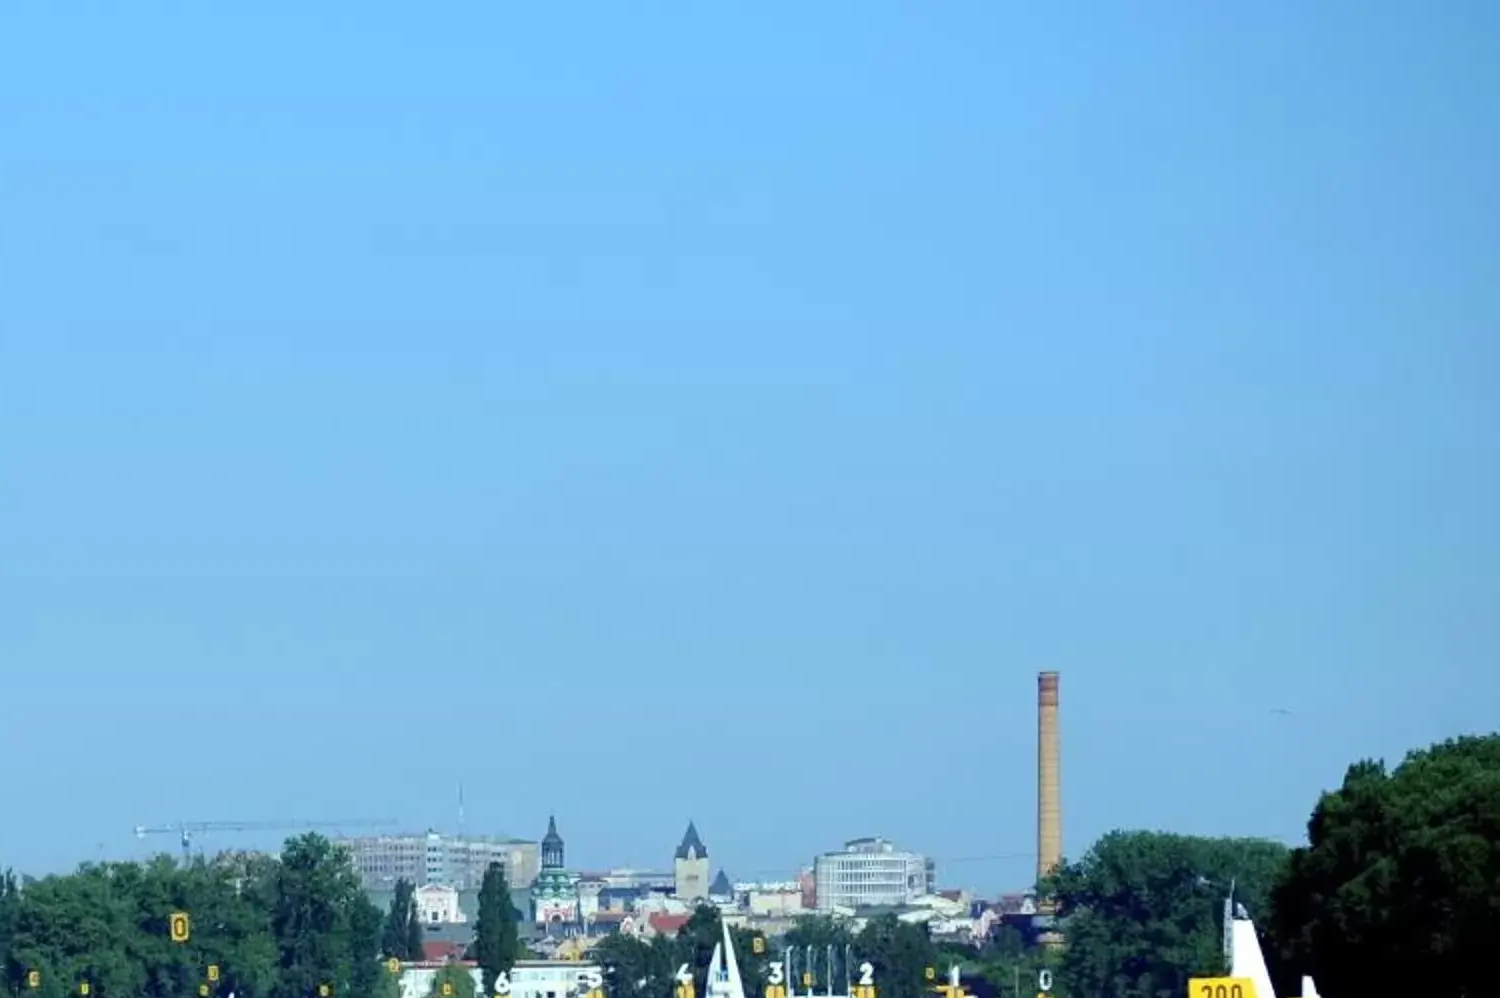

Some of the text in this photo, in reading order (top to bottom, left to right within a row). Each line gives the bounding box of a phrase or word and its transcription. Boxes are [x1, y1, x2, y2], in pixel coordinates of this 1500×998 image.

[173, 917, 186, 938] 0
[494, 970, 510, 994] 6
[587, 966, 603, 989] 5
[675, 963, 693, 986] 4
[768, 961, 784, 985] 3
[859, 961, 874, 985] 2
[951, 965, 960, 987] 1
[1039, 969, 1053, 991] 0
